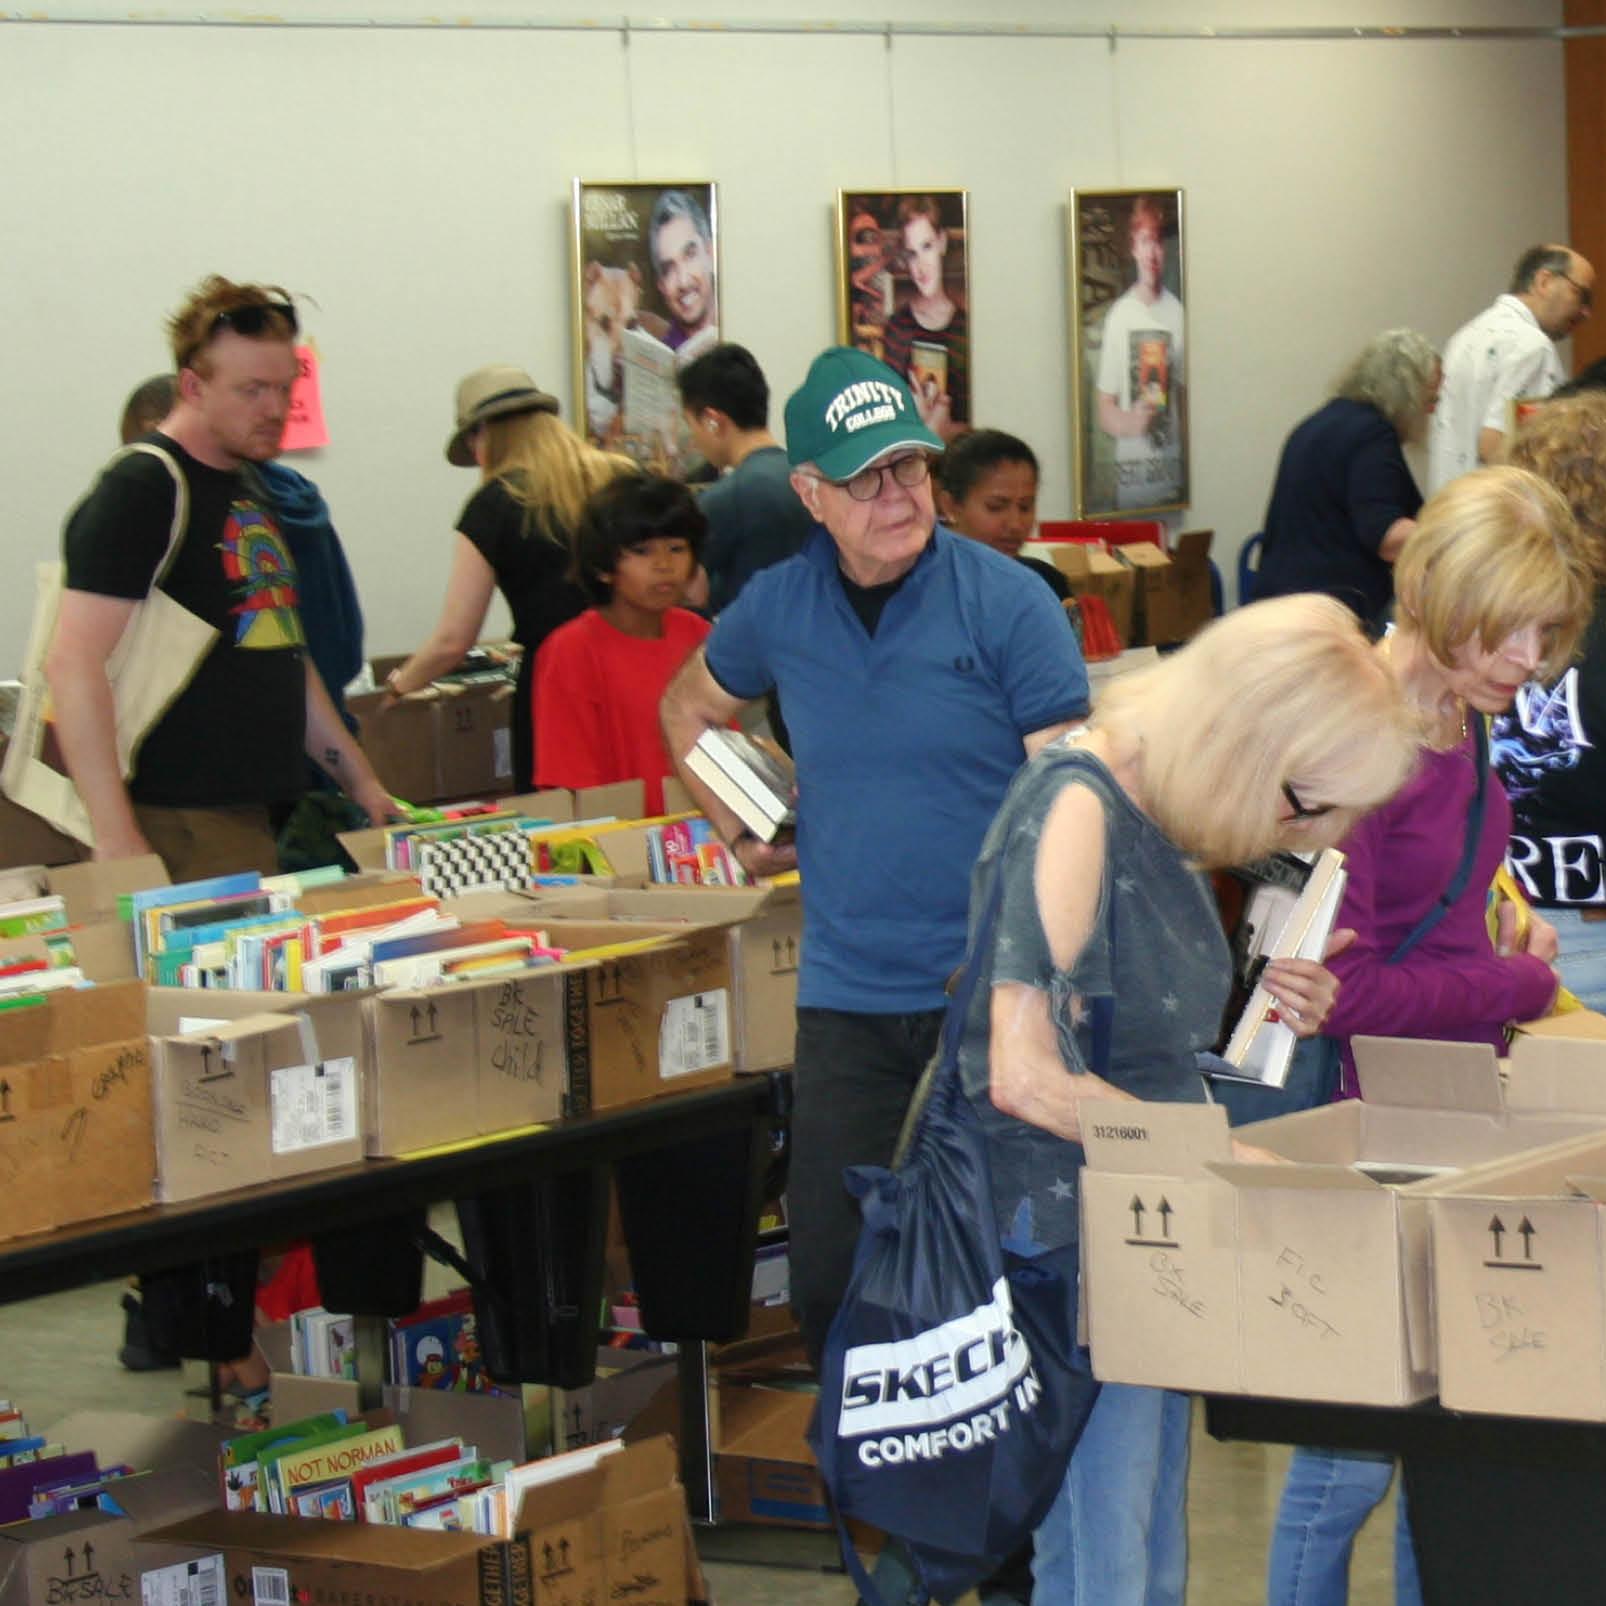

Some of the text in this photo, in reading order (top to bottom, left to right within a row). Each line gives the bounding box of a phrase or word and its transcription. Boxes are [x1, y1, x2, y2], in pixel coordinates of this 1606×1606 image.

[826, 380, 904, 432] TRINITY
[845, 404, 896, 433] COLLEGE
[1093, 1124, 1148, 1141] 31216001
[858, 1401, 1011, 1467] COMFORT
[287, 1438, 398, 1485] NOT NORMAN
